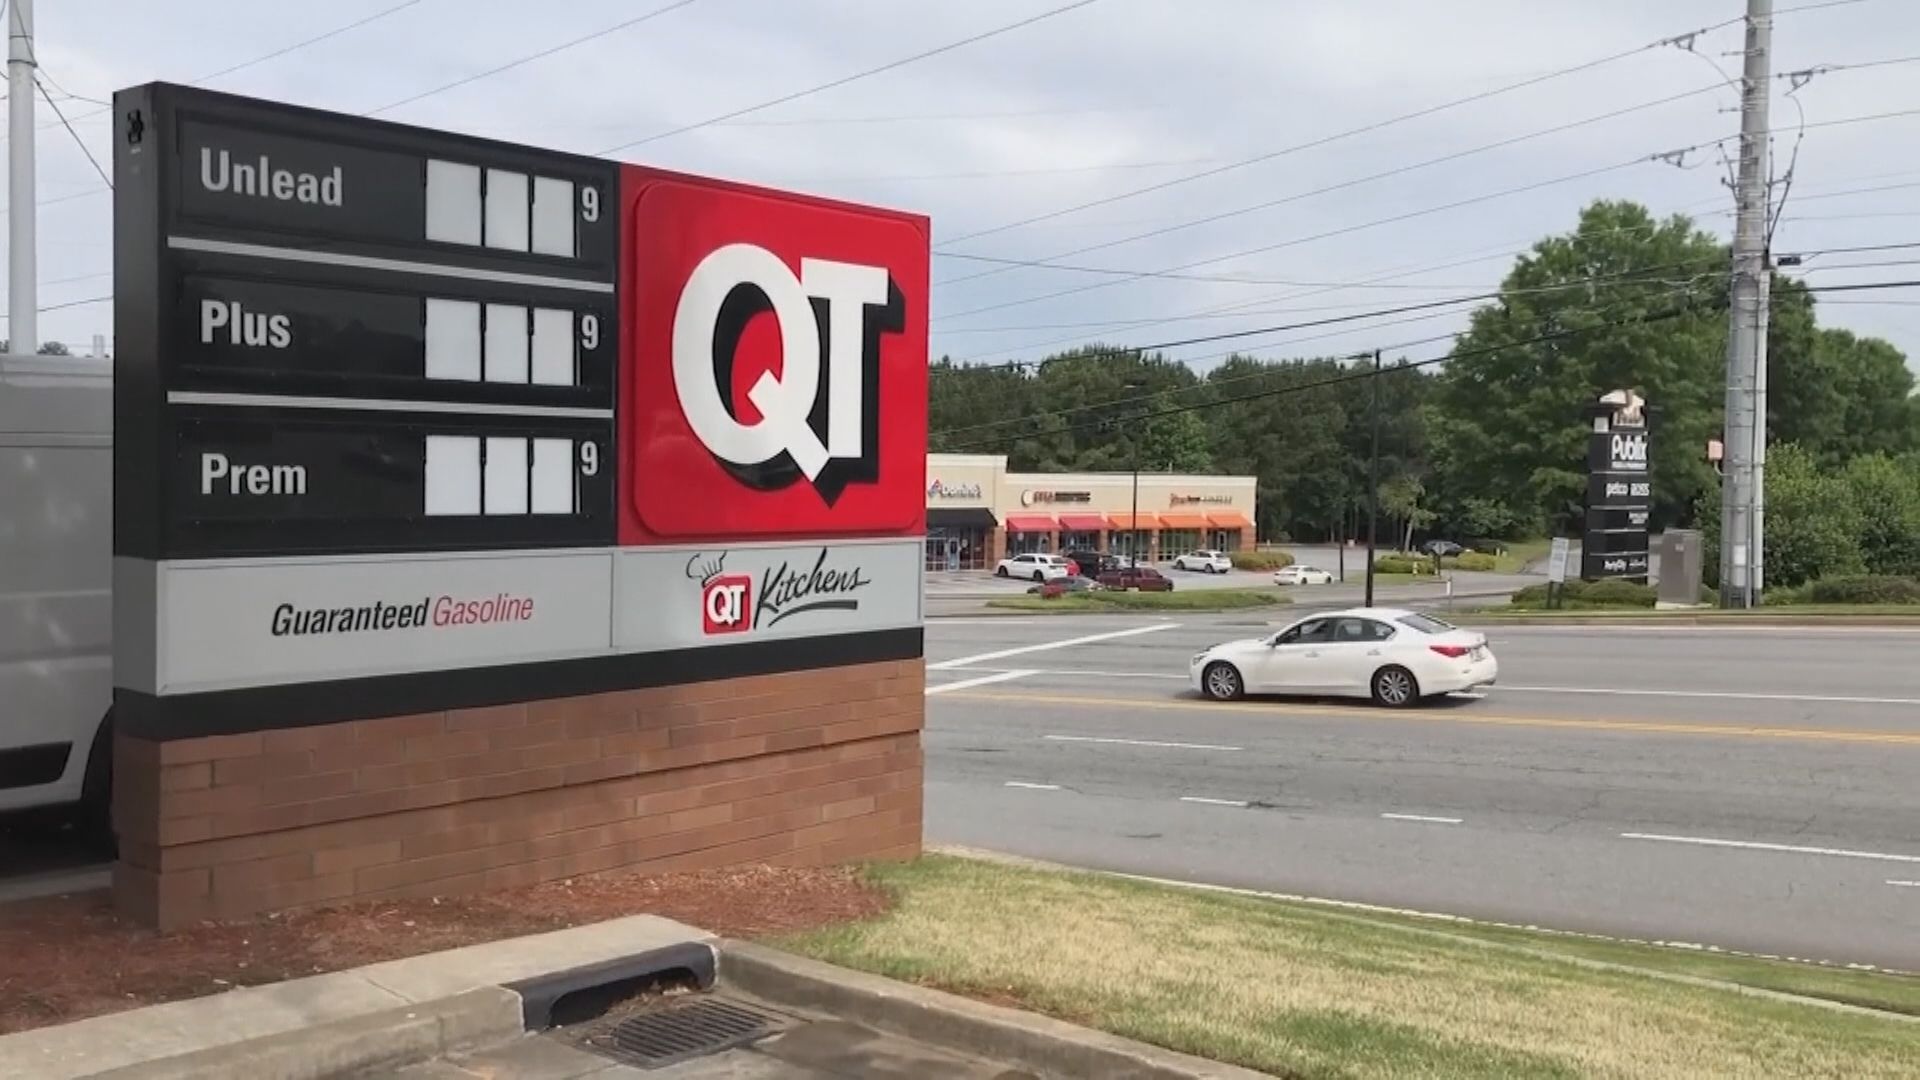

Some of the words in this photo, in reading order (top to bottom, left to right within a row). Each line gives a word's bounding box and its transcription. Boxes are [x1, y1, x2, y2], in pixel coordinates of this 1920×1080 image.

[200, 148, 343, 206] Unlead
[581, 187, 598, 222] 9
[201, 300, 292, 349] Plus
[581, 315, 598, 349] 9
[672, 242, 889, 483] QT
[201, 453, 307, 495] Prem
[581, 441, 598, 475] 9
[706, 585, 745, 626] QT
[753, 547, 871, 629] Kitchens
[271, 597, 430, 637] Guaranteed
[432, 593, 534, 628] Gasoline
